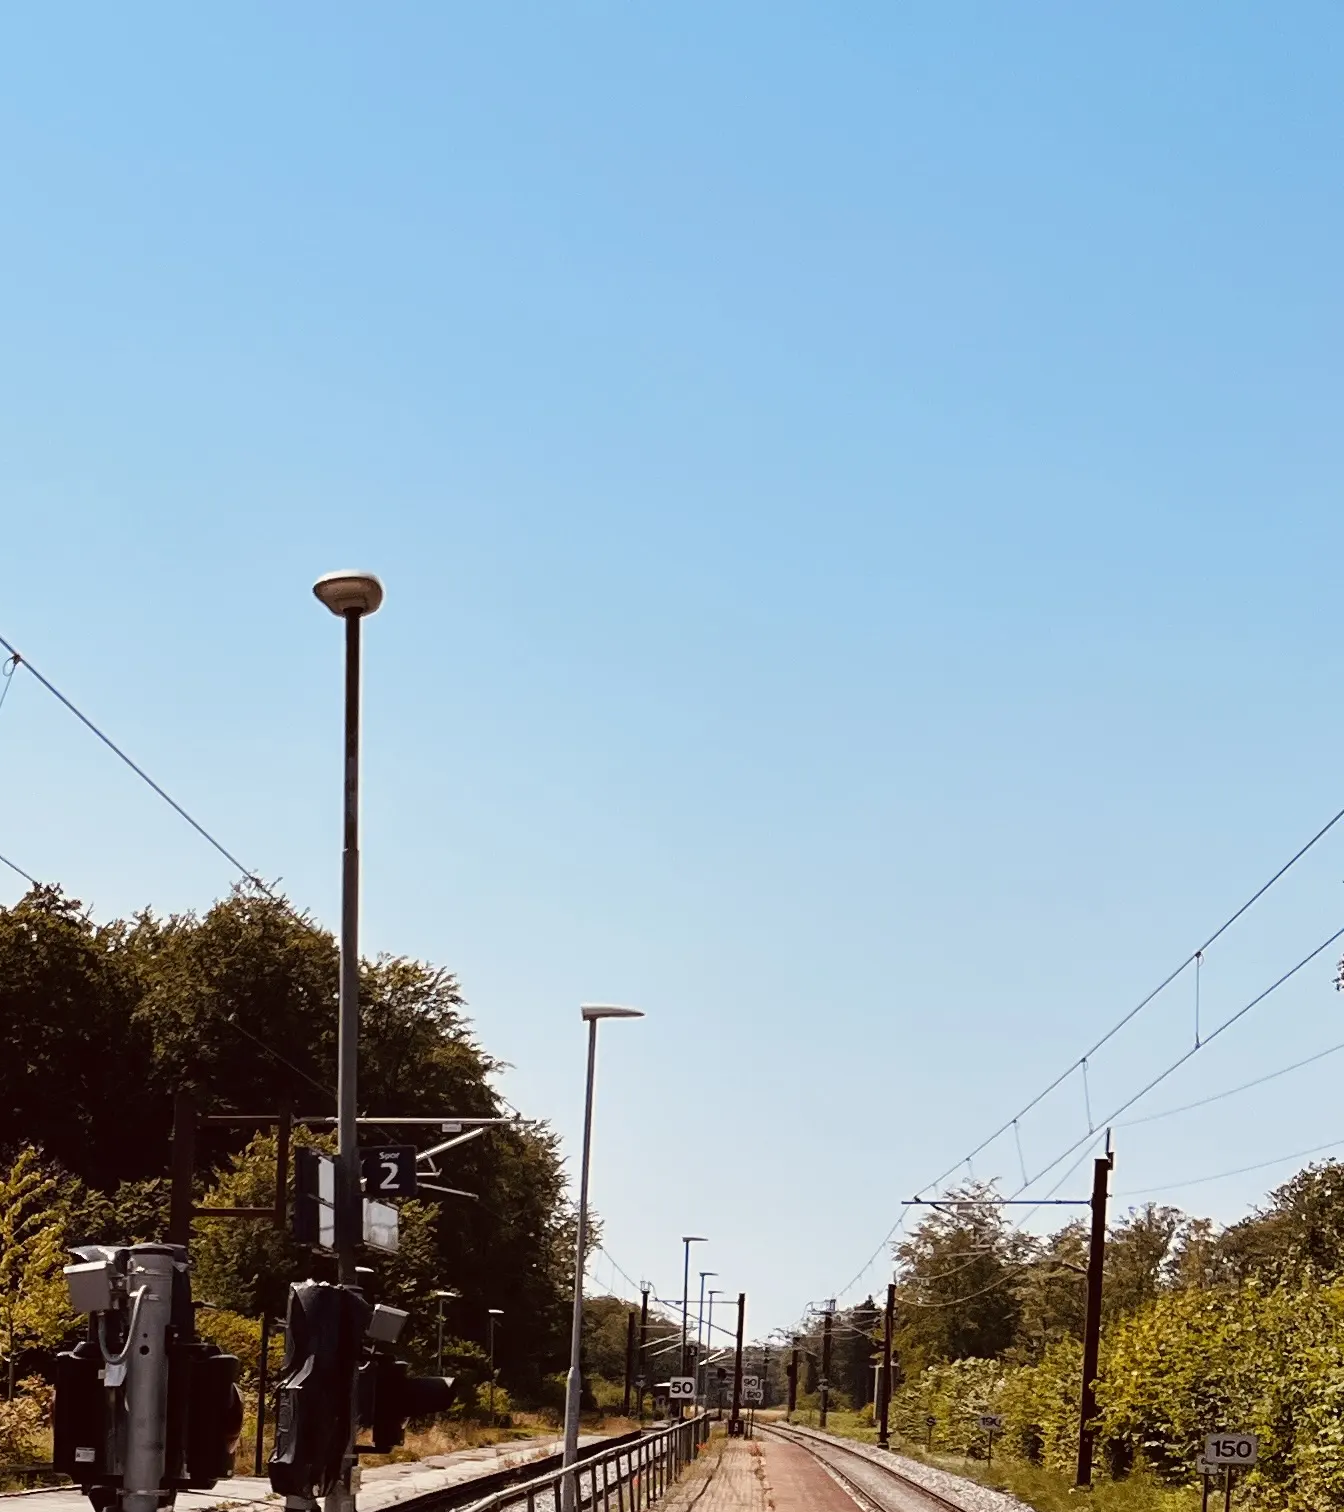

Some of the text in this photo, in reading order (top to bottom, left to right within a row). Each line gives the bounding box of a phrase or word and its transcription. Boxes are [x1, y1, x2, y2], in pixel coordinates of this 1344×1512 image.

[379, 1151, 400, 1161] Spor
[379, 1162, 400, 1190] 2
[672, 1382, 693, 1394] 50
[1211, 1440, 1252, 1458] 150
